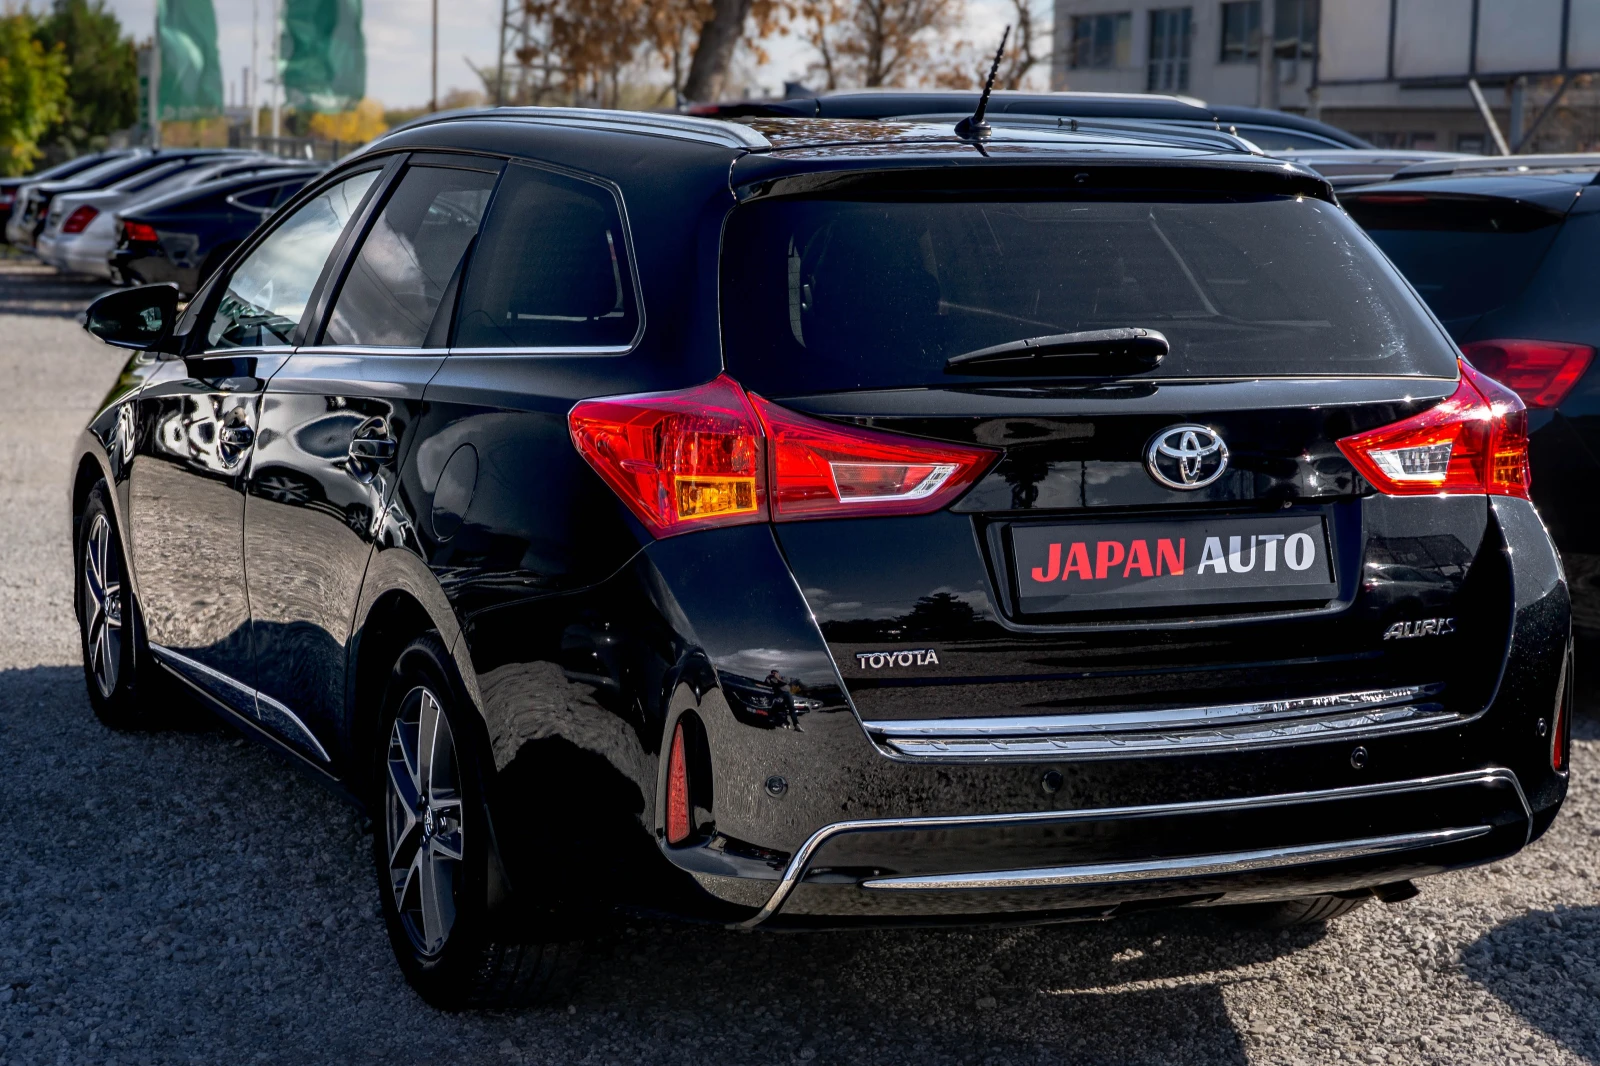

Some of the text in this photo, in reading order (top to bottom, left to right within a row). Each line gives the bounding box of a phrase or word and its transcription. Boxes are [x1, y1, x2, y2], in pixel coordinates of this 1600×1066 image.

[1032, 533, 1316, 582] JAPAN AUTO
[1383, 618, 1454, 640] AURIS
[857, 649, 939, 669] TOYOTA
